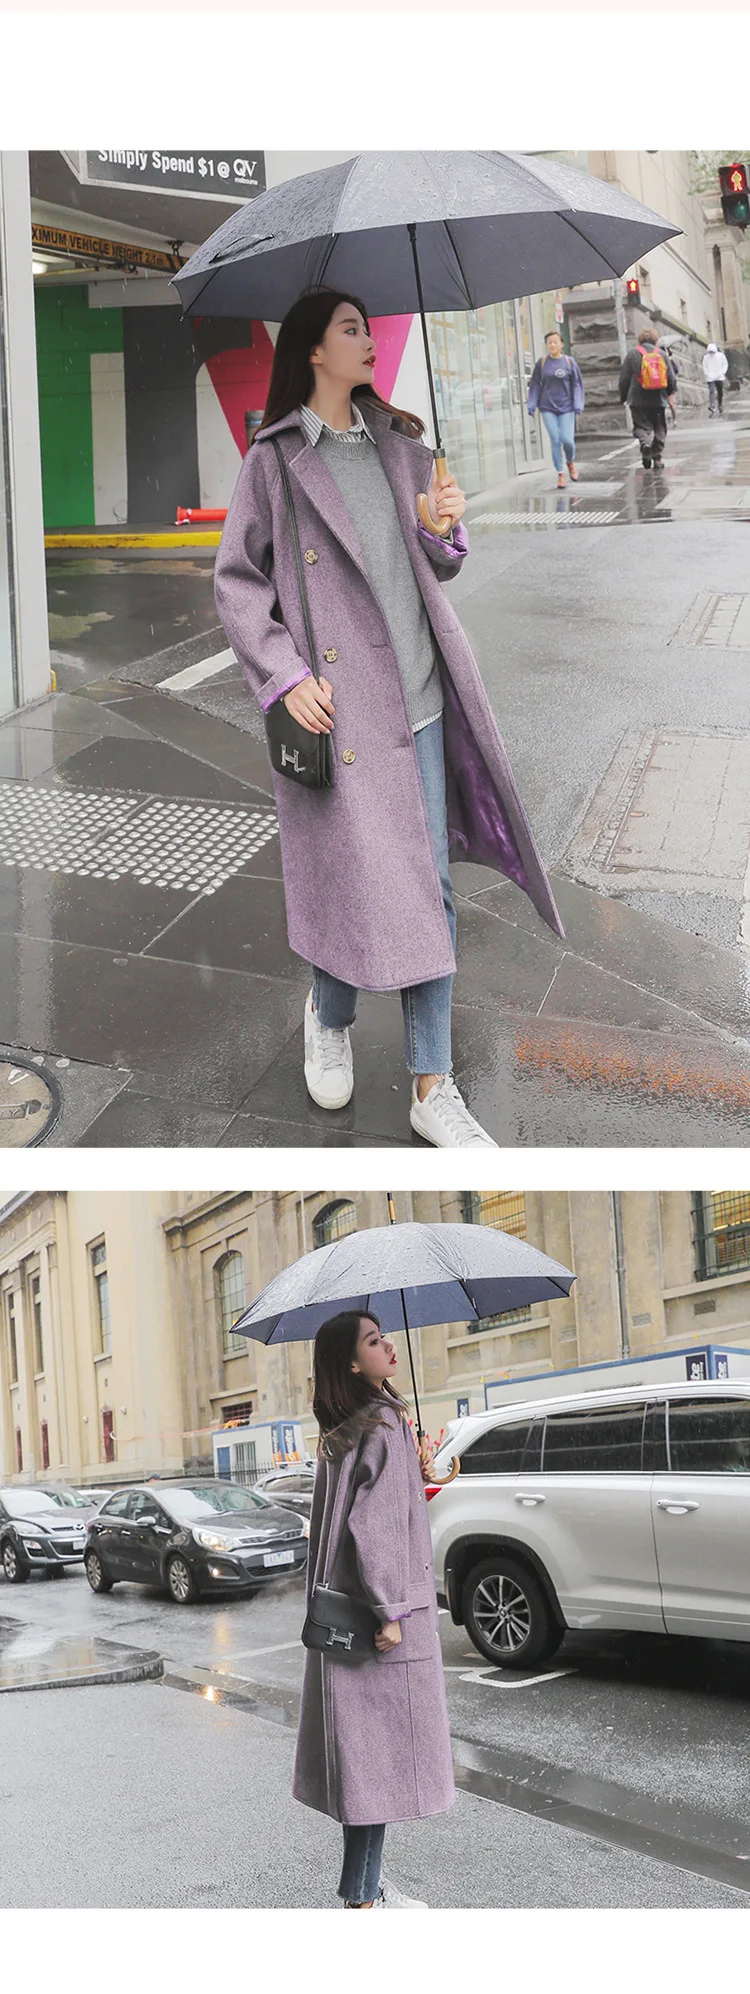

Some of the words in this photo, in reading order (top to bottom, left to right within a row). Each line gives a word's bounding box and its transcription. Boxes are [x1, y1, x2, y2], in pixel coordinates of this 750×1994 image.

[98, 150, 148, 171] Simply
[152, 151, 195, 174] Spend
[198, 157, 214, 178] $1
[217, 161, 230, 179] @
[233, 158, 258, 177] QV
[32, 227, 67, 246] XIMUM
[69, 234, 110, 255] VEHICLE
[112, 245, 143, 262] HEIGHT
